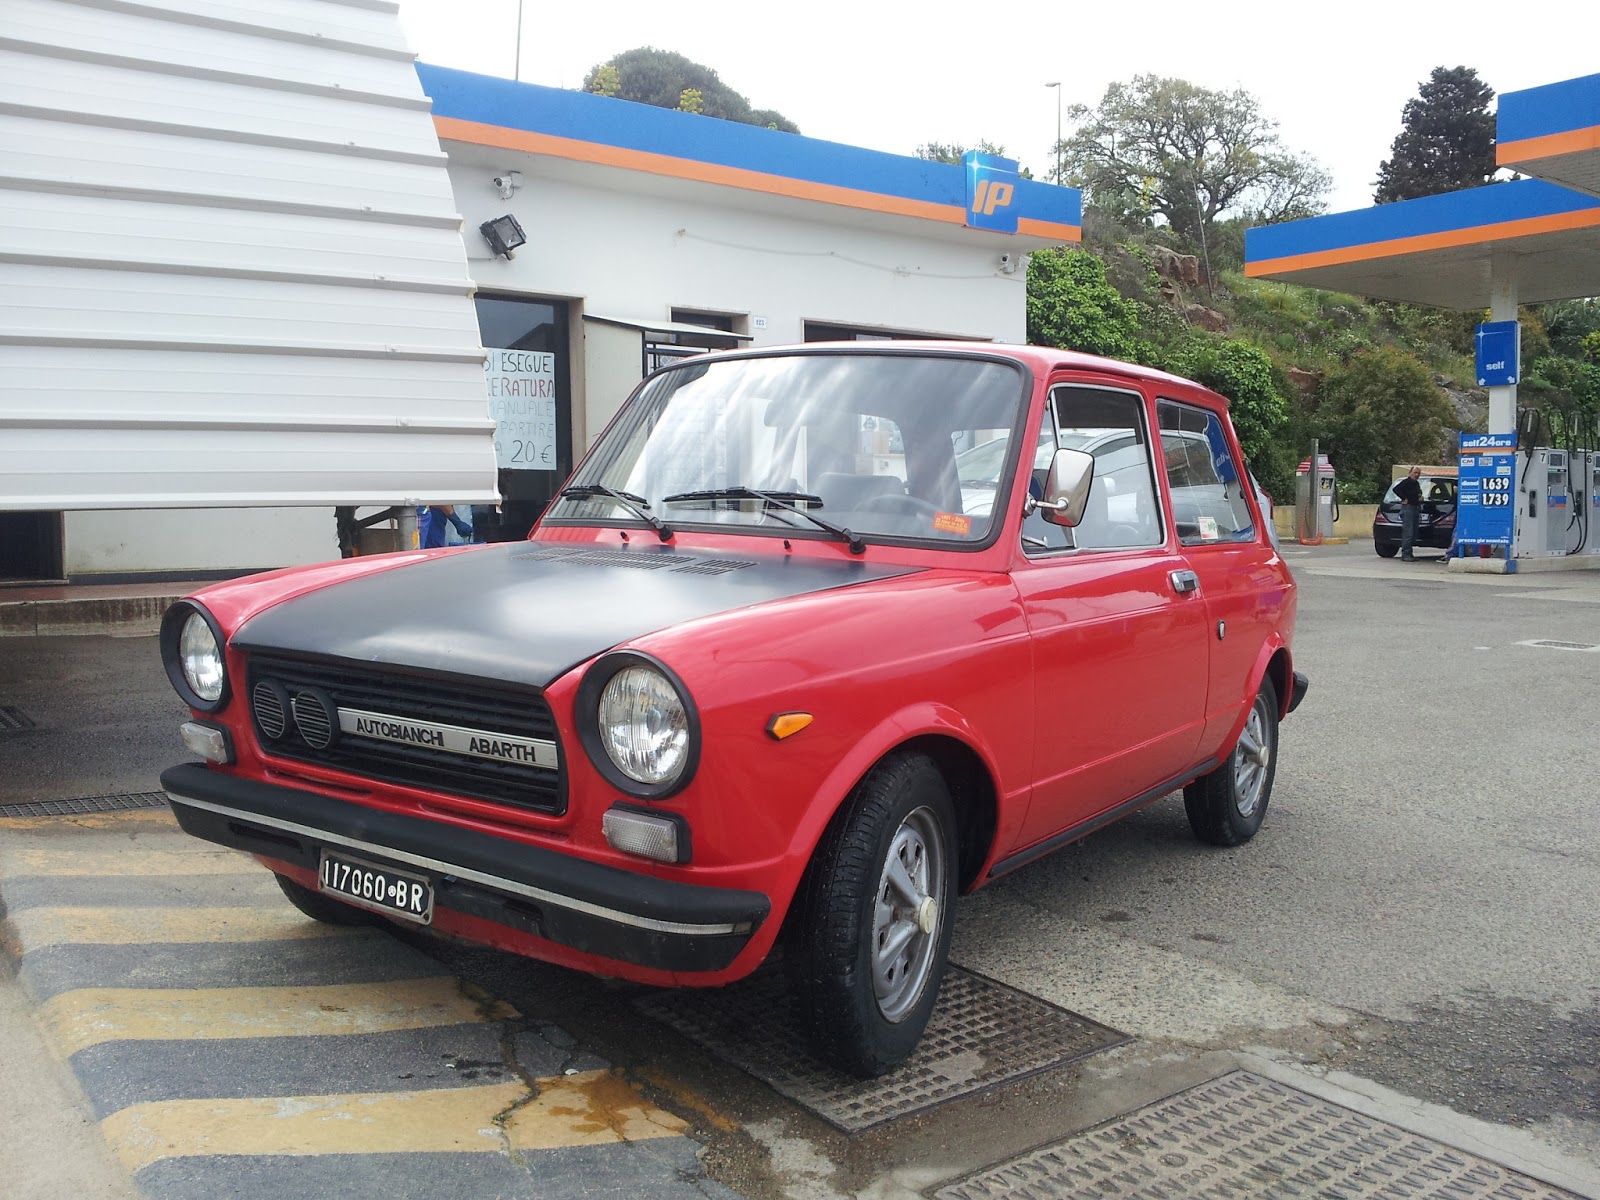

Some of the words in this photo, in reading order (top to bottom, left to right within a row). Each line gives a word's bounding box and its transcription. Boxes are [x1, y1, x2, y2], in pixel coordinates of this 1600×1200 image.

[972, 179, 1014, 215] IP
[502, 353, 551, 373] ESEGUE
[1486, 360, 1505, 371] self
[487, 377, 555, 398] ERATURA
[501, 420, 554, 439] PARTIRE
[511, 440, 535, 463] 20
[540, 444, 552, 464] €
[1540, 453, 1546, 462] 7
[1586, 454, 1593, 464] 6
[1482, 478, 1510, 490] 1.639
[1482, 493, 1509, 505] 1.739
[356, 717, 444, 747] AUTOBIANCHI
[469, 737, 536, 762] ABARTH
[325, 860, 386, 901] 117060
[396, 880, 424, 912] BR
